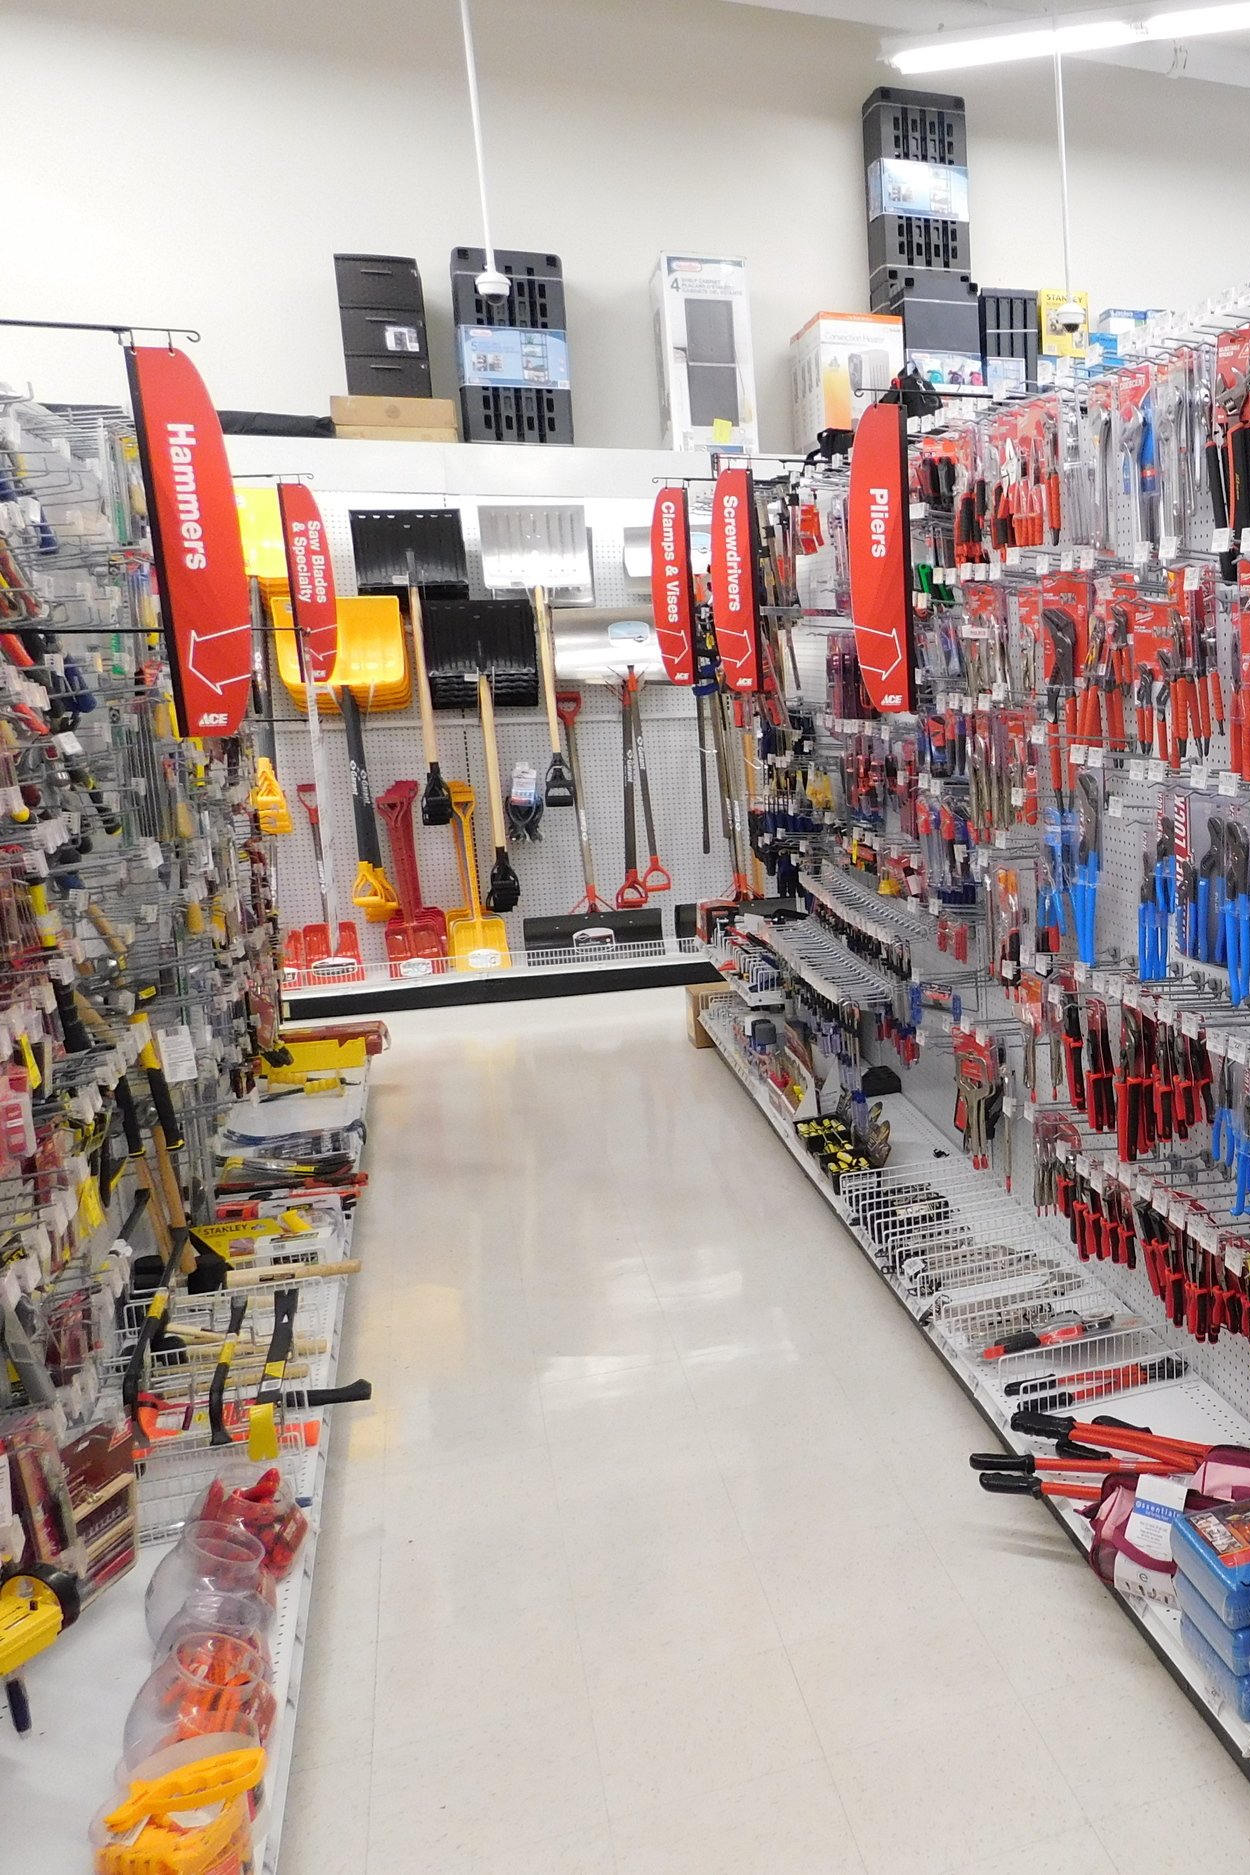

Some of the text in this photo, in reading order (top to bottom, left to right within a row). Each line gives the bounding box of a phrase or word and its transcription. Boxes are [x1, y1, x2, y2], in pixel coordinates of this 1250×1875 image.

[670, 277, 681, 292] 4
[1046, 293, 1083, 304] STANEY
[166, 423, 207, 570] Hammers
[869, 488, 888, 558] Pliers
[722, 495, 741, 612] Screwdrivers
[291, 521, 311, 602] & Specialty
[307, 520, 327, 604] Saw Blades
[661, 501, 679, 623] Clamps & Vises
[675, 671, 689, 681] ACE
[736, 677, 752, 687] ACE
[881, 694, 903, 706] ACE
[199, 713, 228, 727] ACE
[203, 1223, 248, 1236] STANLEY
